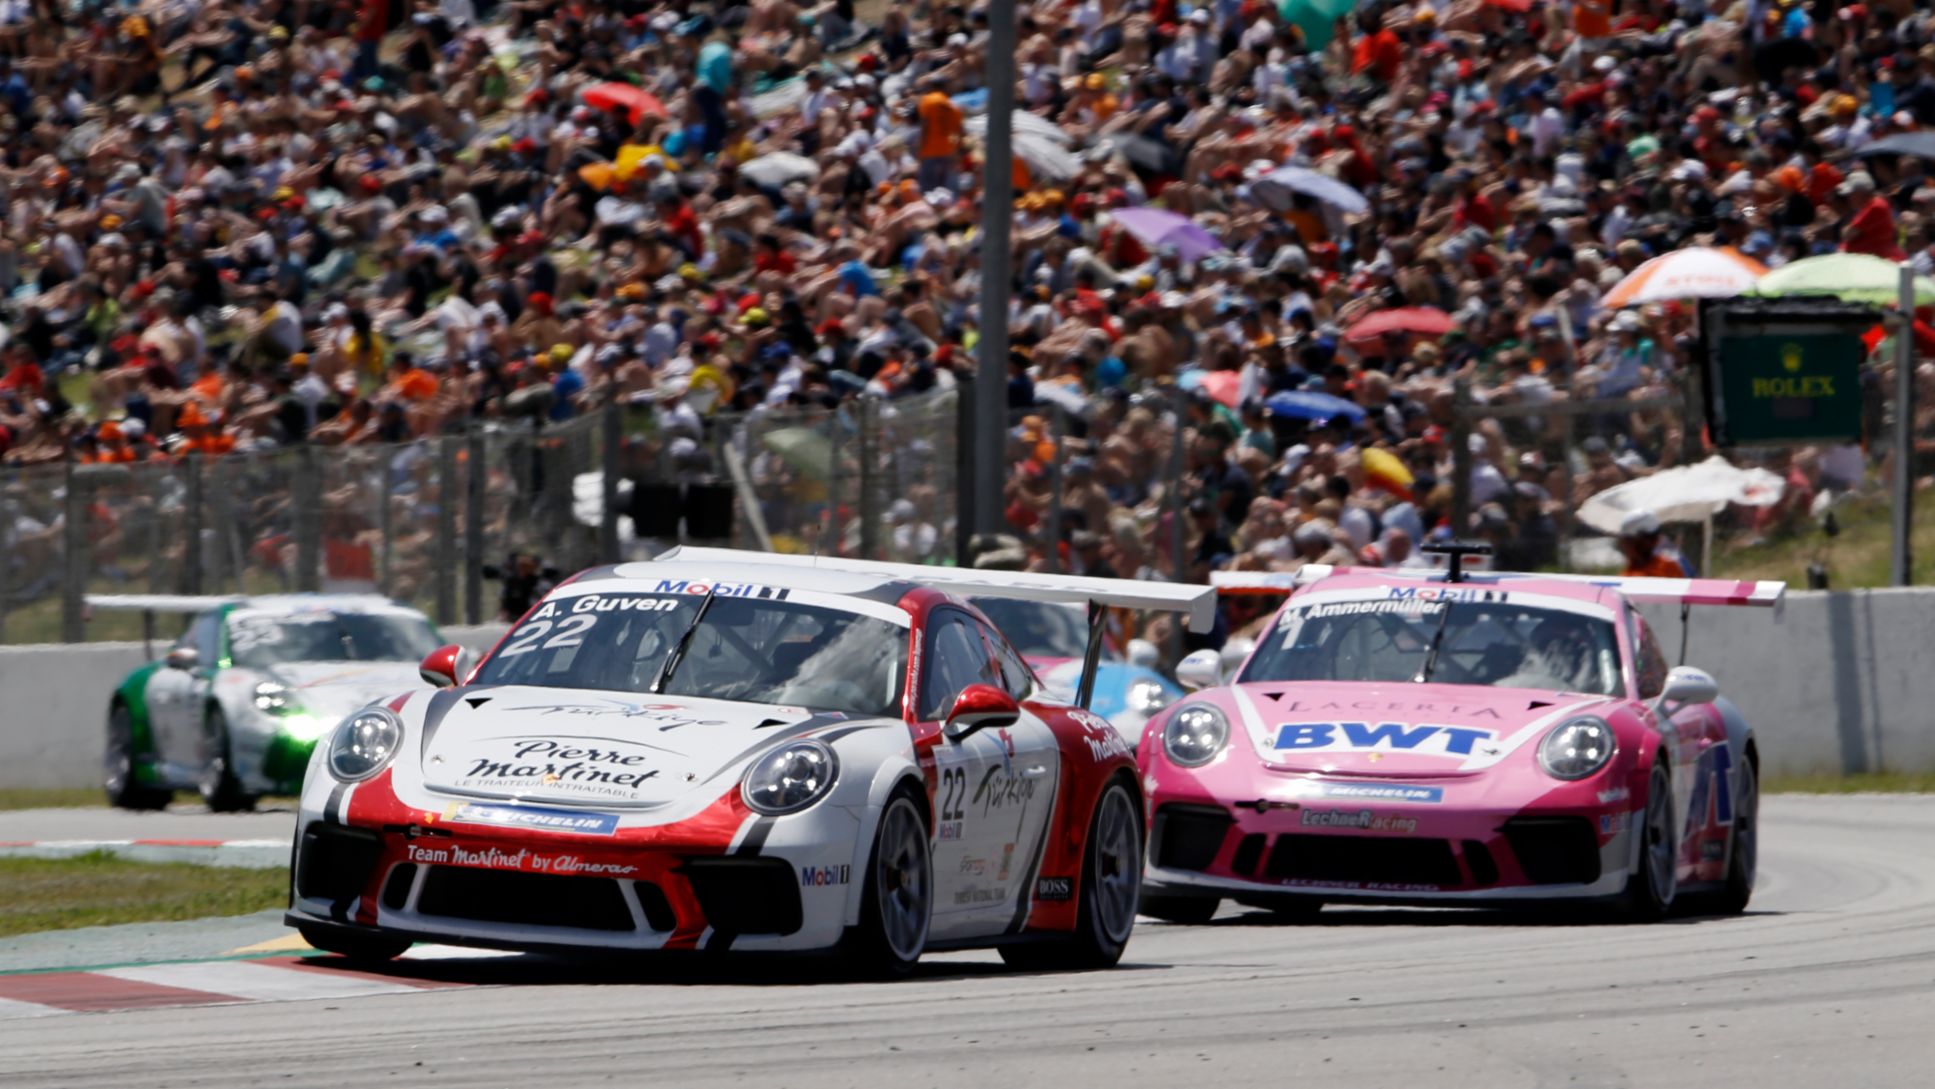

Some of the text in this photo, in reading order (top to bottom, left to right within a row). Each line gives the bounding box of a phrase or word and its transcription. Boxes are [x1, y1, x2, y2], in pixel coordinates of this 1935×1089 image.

[1753, 376, 1836, 397] ROLEX
[653, 579, 753, 598] Mobil
[1388, 586, 1476, 603] Mobil
[529, 595, 679, 622] A. Guven
[1304, 599, 1447, 620] Ammermüller
[499, 613, 598, 658] 22
[1277, 616, 1305, 651] 1
[1274, 722, 1492, 755] BWT
[513, 739, 646, 766] Pierre
[466, 758, 660, 789] Martinet
[942, 766, 966, 821] 22
[1330, 786, 1432, 799] MICHELIN
[407, 844, 448, 862] Team
[450, 844, 527, 869] Martinet
[532, 854, 551, 873] by
[802, 865, 839, 887] Mobil
[1039, 879, 1069, 894] BOSS
